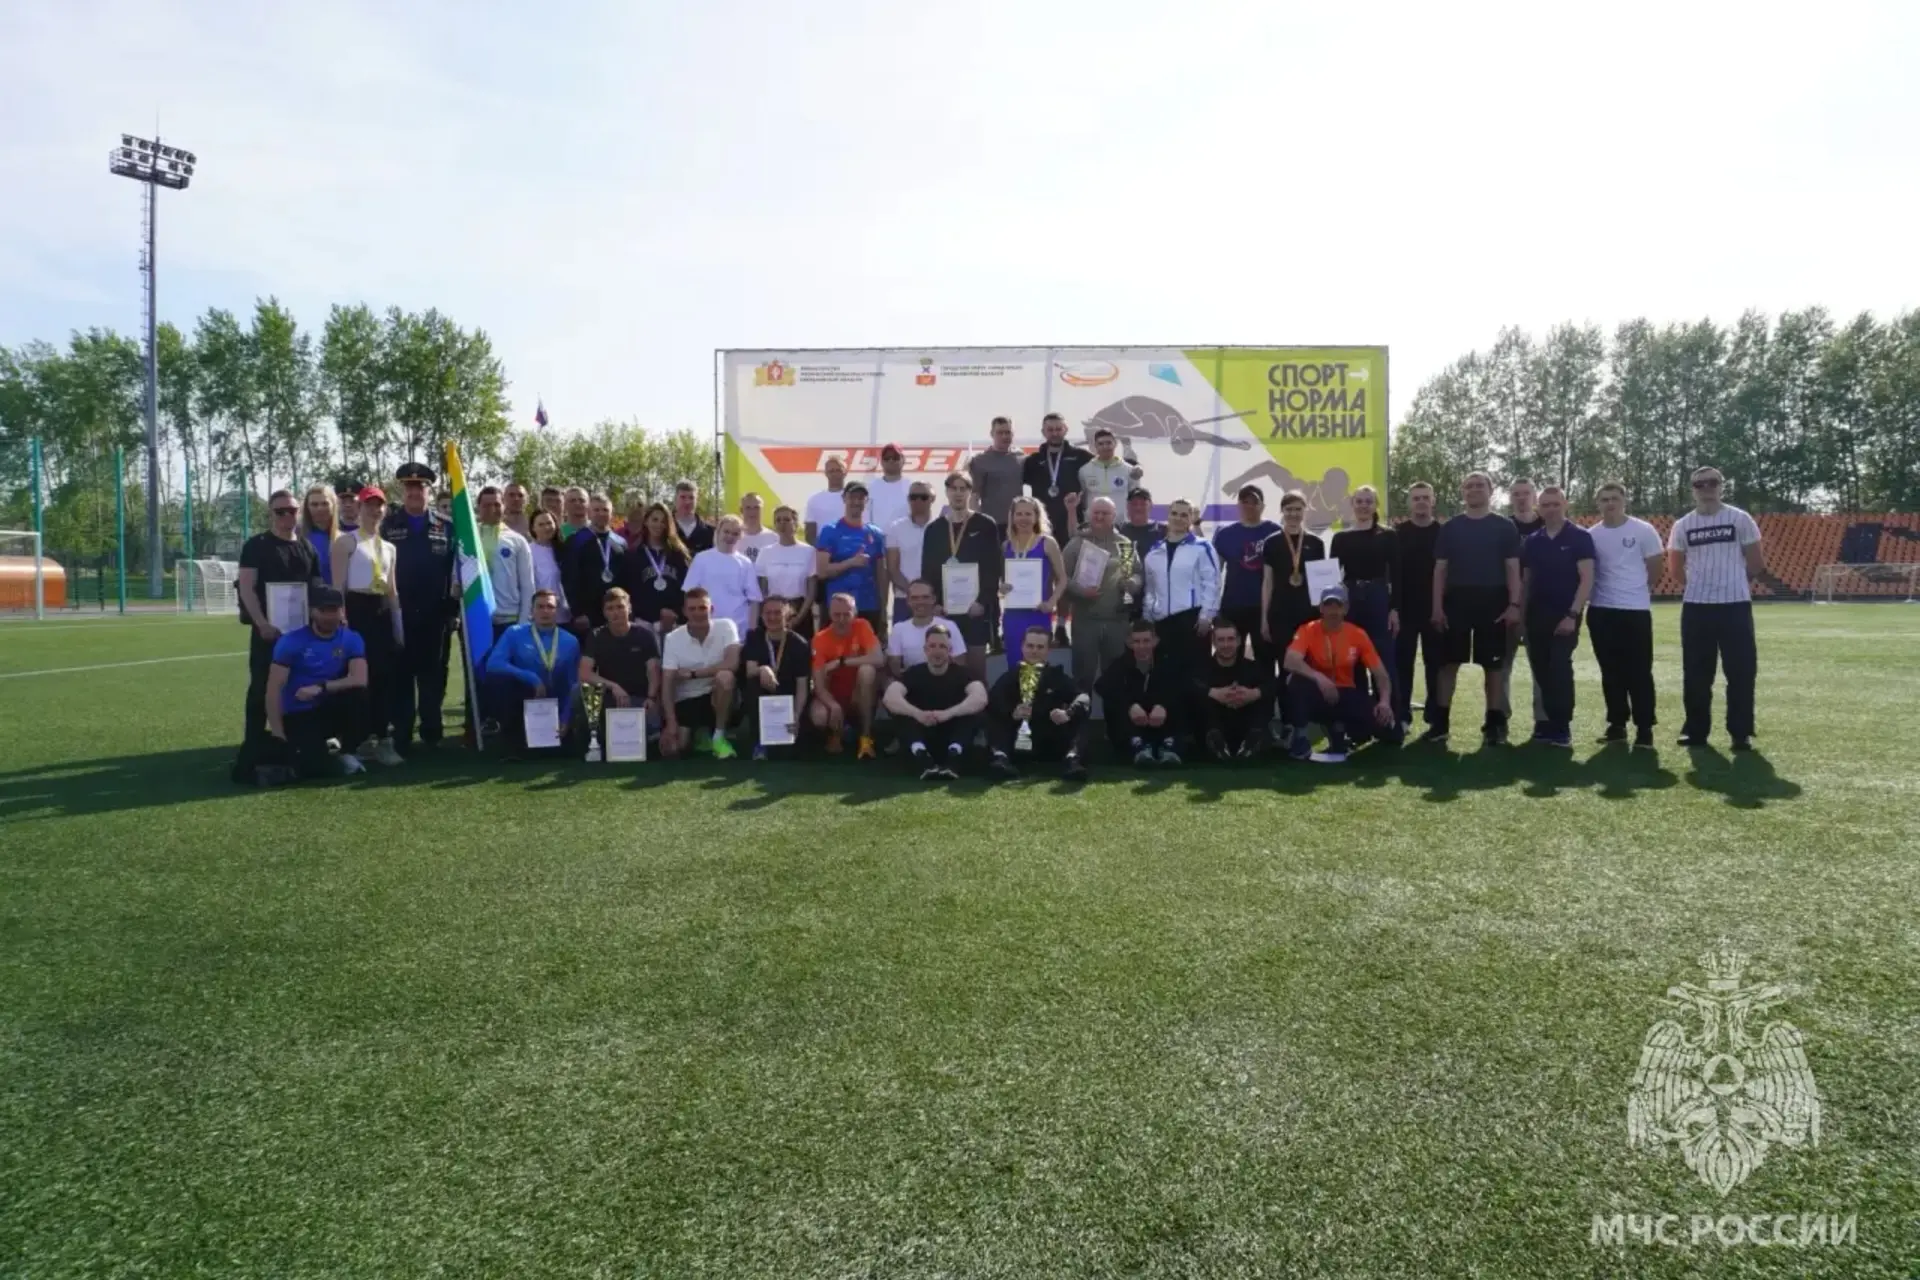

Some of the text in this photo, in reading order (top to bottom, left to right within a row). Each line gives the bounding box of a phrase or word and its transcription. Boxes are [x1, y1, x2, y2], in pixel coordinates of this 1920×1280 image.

[1268, 363, 1349, 387] СПОРТ
[1268, 388, 1366, 412] НОРМА
[1269, 414, 1366, 438] ЖИЗНИ
